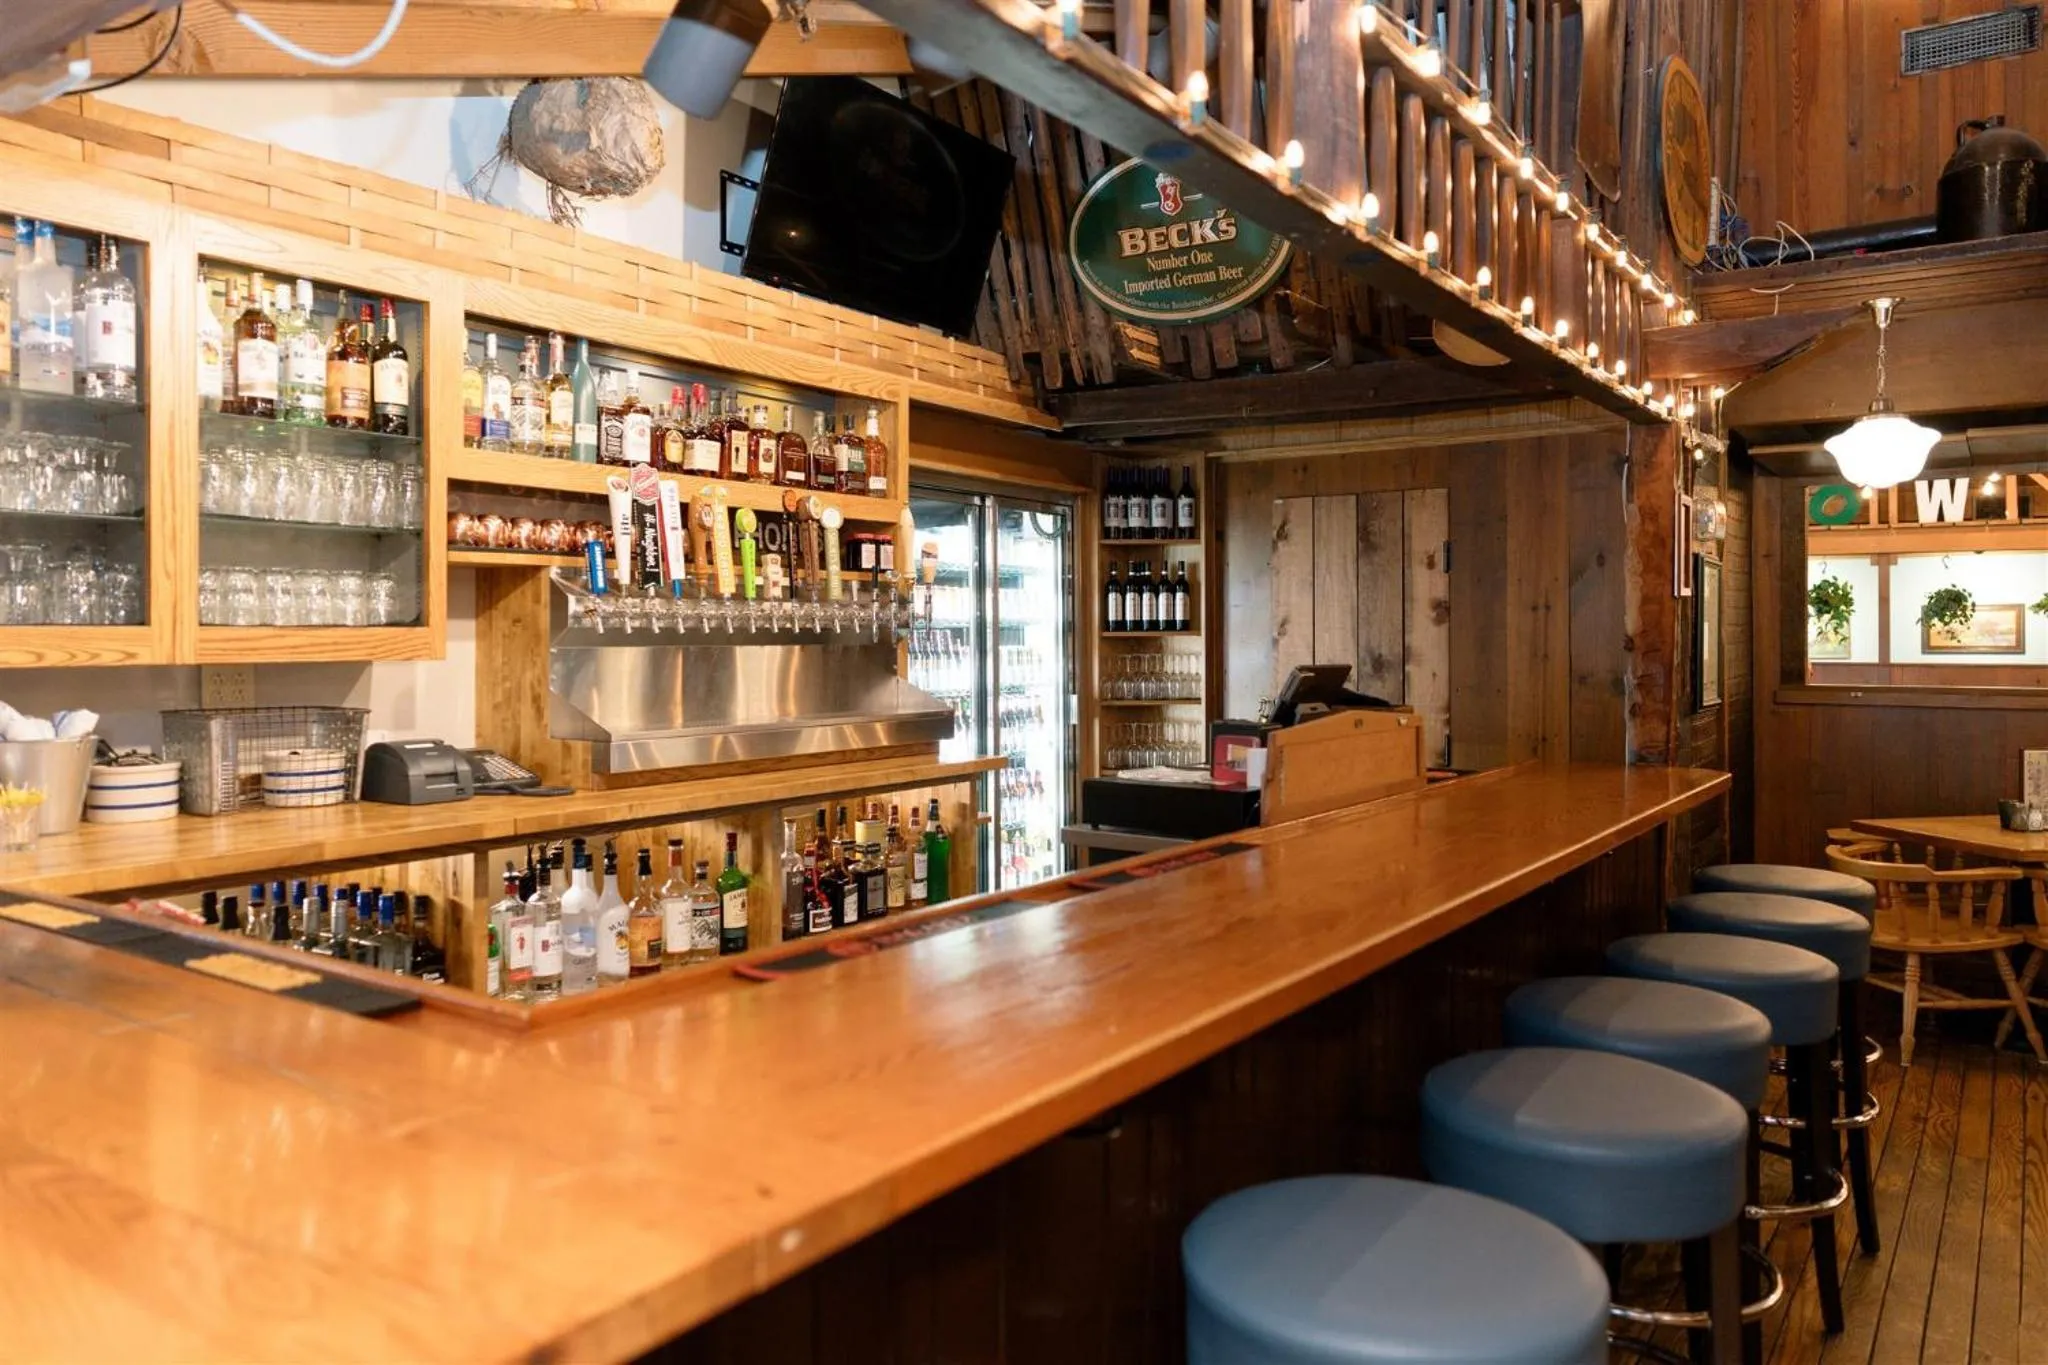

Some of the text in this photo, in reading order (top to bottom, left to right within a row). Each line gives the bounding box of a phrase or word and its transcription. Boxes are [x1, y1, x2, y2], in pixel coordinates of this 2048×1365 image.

[1117, 209, 1237, 257] BECK'S
[1147, 248, 1214, 272] Number One
[1124, 274, 1171, 296] Imported
[1173, 269, 1216, 289] German
[1219, 264, 1243, 281] Beer
[1914, 477, 1970, 524] W
